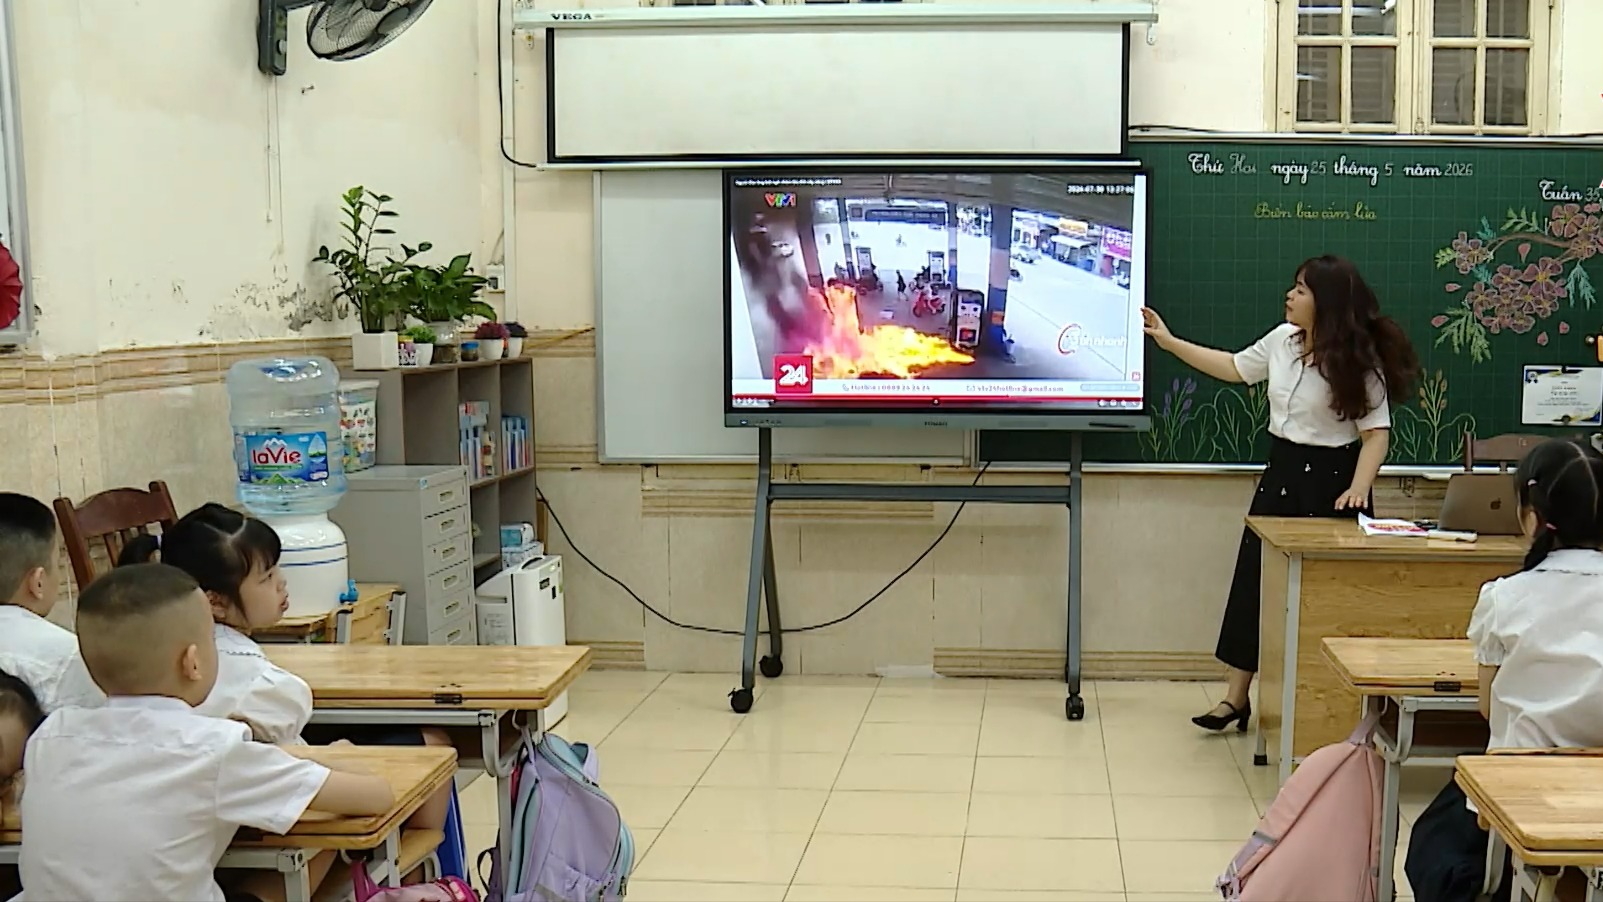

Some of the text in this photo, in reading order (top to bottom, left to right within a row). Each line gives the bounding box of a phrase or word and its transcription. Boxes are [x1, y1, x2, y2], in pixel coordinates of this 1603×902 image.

[1188, 153, 1225, 174] Thứ
[1270, 160, 1309, 184] ngày
[1310, 161, 1327, 174] 25
[1334, 155, 1379, 186] tháng
[1384, 163, 1394, 176] 5
[1403, 163, 1442, 176] năm
[1444, 163, 1473, 176] 2026
[1584, 187, 1600, 202] 35
[779, 364, 809, 386] 24
